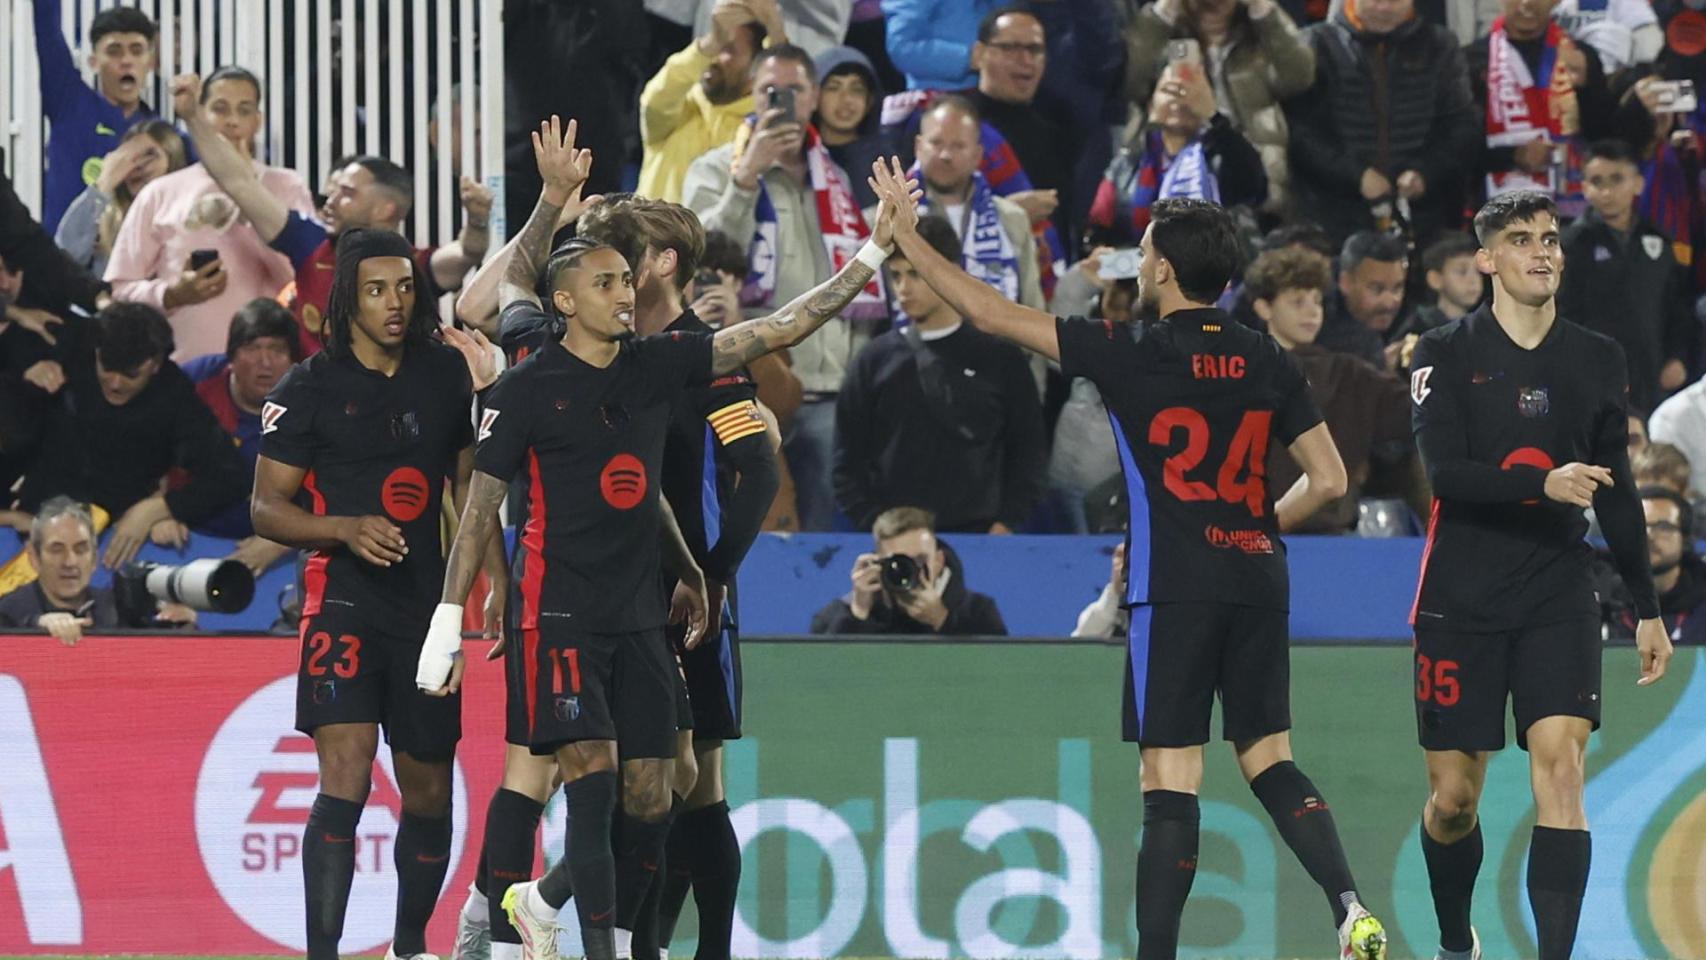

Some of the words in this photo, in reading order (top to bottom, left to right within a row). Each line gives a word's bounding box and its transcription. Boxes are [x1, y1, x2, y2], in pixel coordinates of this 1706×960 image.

[1192, 354, 1246, 379] ERIC
[1148, 406, 1273, 517] 24
[308, 631, 361, 678] 23
[549, 648, 581, 693] 11
[1417, 654, 1460, 706] 35
